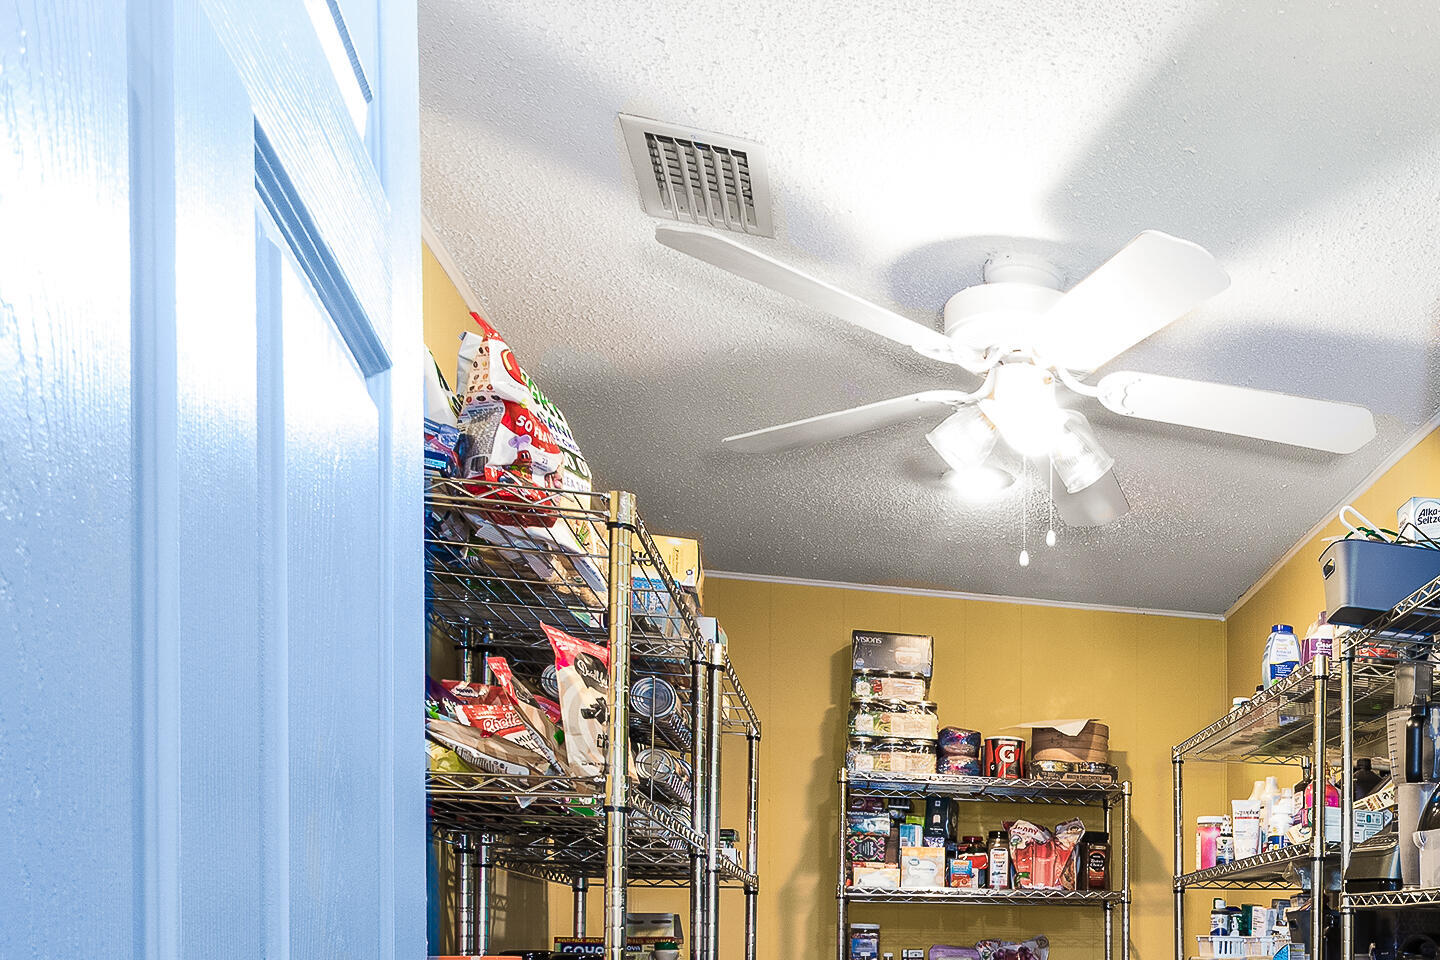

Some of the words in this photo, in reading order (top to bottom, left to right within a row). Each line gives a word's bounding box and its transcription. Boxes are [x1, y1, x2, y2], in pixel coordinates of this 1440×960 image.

[516, 416, 533, 433] 50
[1419, 508, 1440, 517] Alka-
[999, 744, 1015, 763] G
